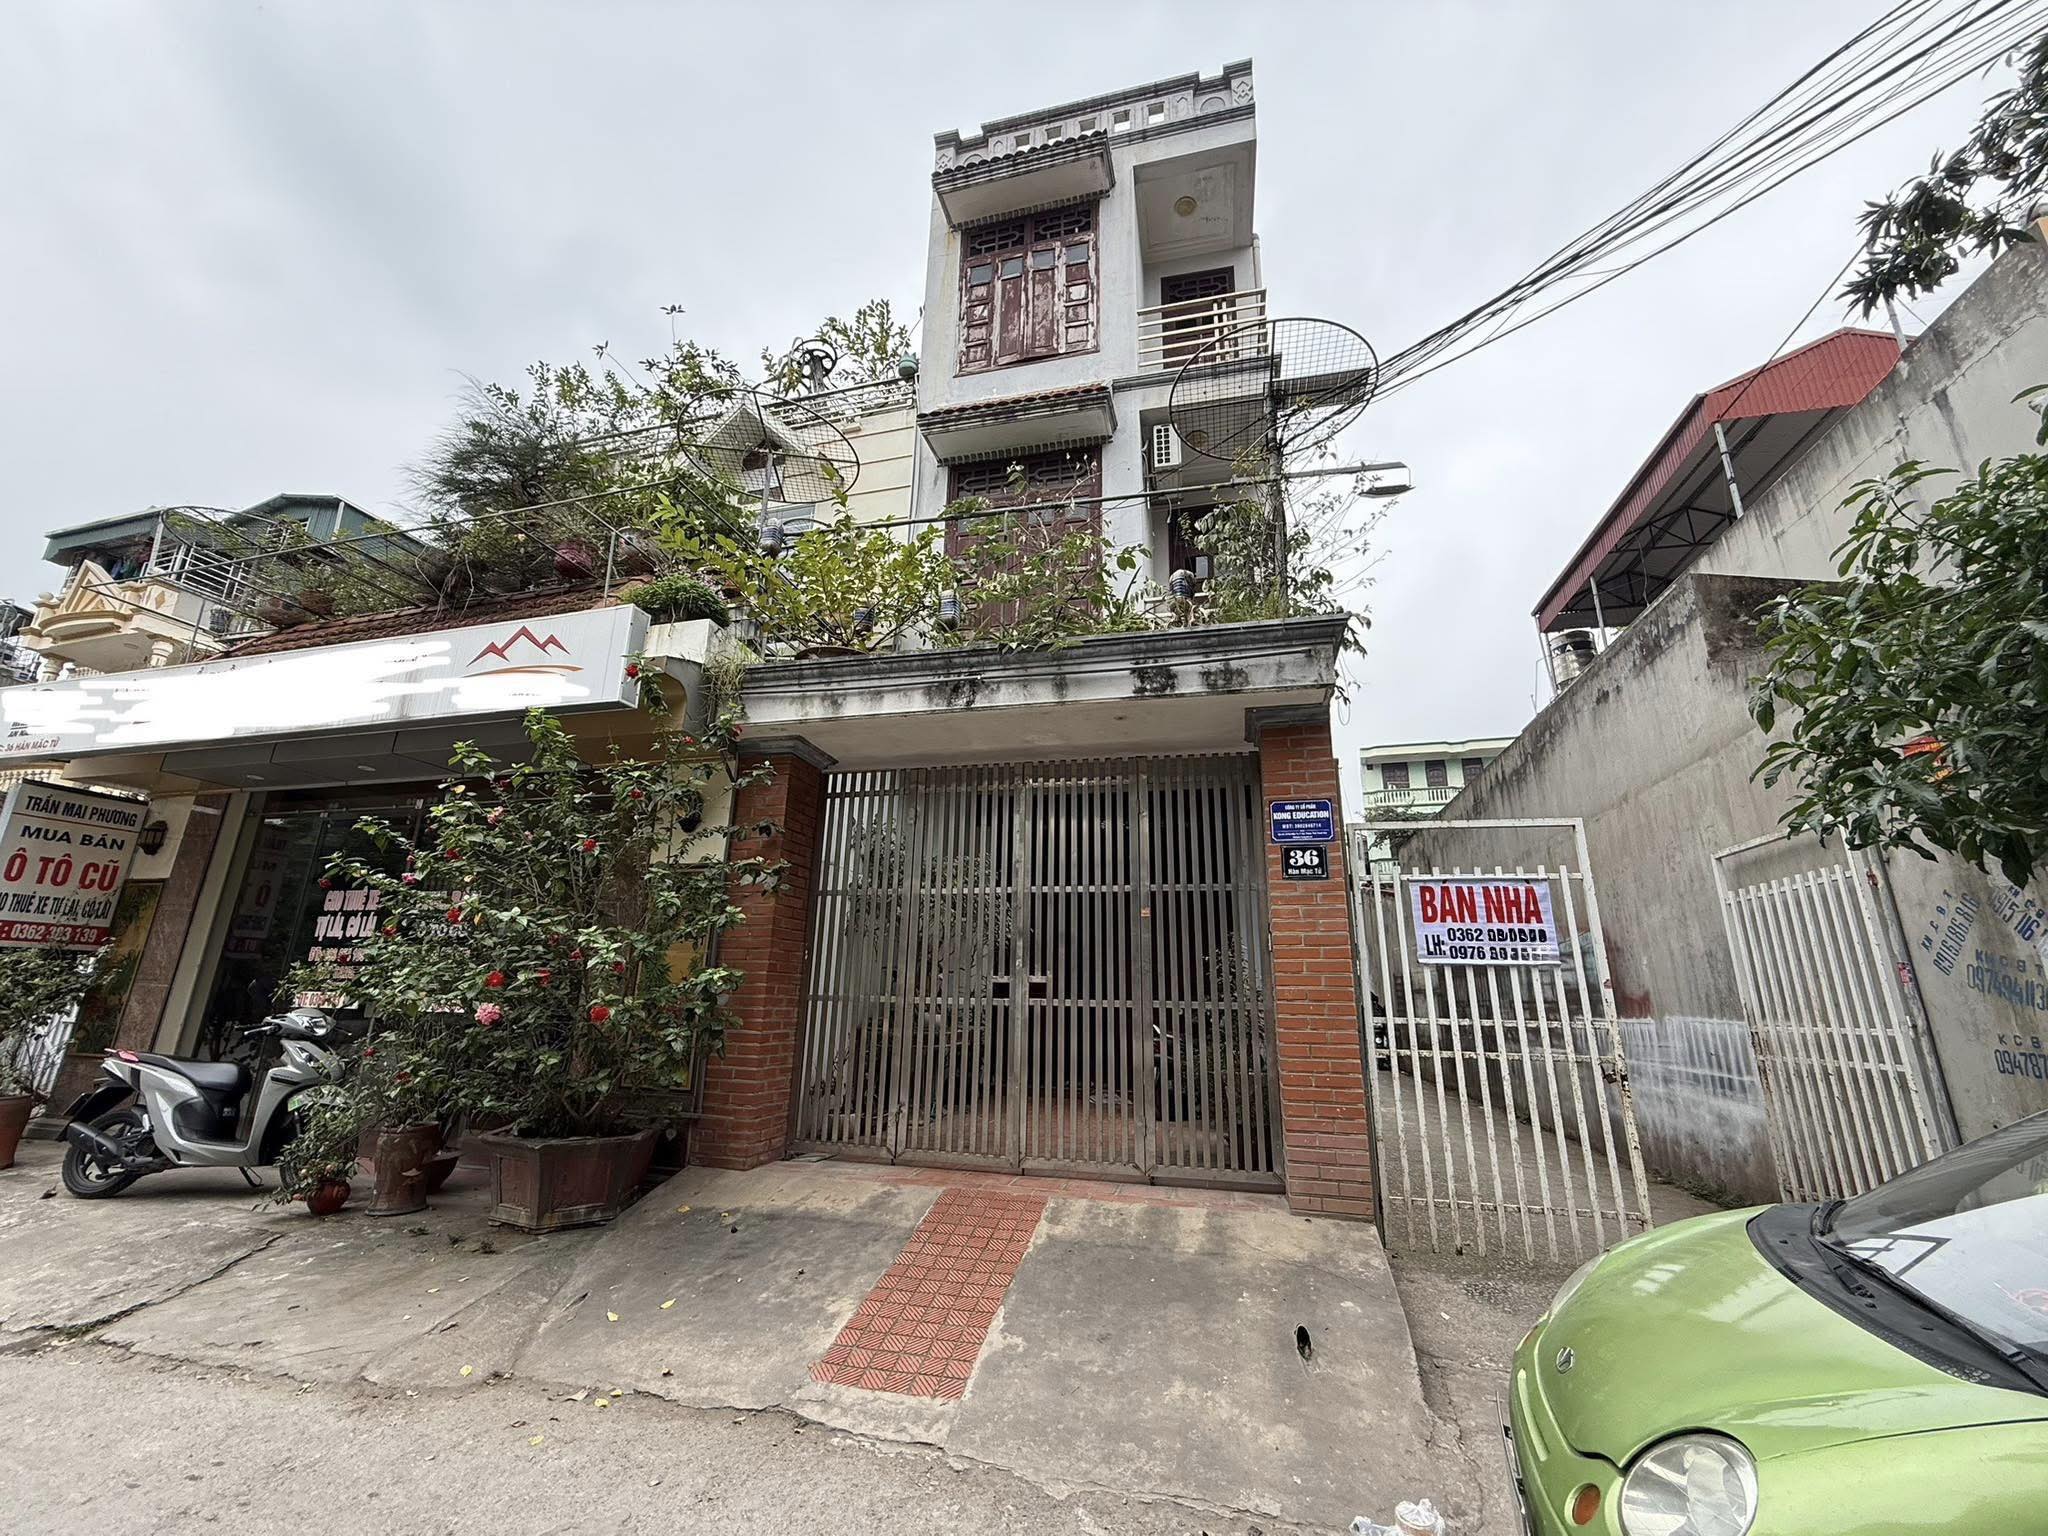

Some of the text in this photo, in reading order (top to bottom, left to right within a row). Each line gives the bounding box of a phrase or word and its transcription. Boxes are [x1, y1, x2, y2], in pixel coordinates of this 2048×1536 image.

[25, 794, 138, 827] TRẦN MAI PHƯƠNG
[1292, 810, 1329, 819] EDUCATION
[20, 825, 125, 851] MUA BÁN
[1290, 849, 1319, 866] 36
[3, 847, 120, 892] Ô TÔ CŨ
[33, 895, 51, 914] XE
[1419, 879, 1544, 924] BÁN NHÀ
[10, 923, 45, 940] 0362
[74, 927, 98, 943] 139
[1424, 934, 1447, 956] LH:
[1447, 927, 1484, 942] 0362
[1450, 945, 1486, 960] 0976
[1997, 1034, 2042, 1049] K C B
